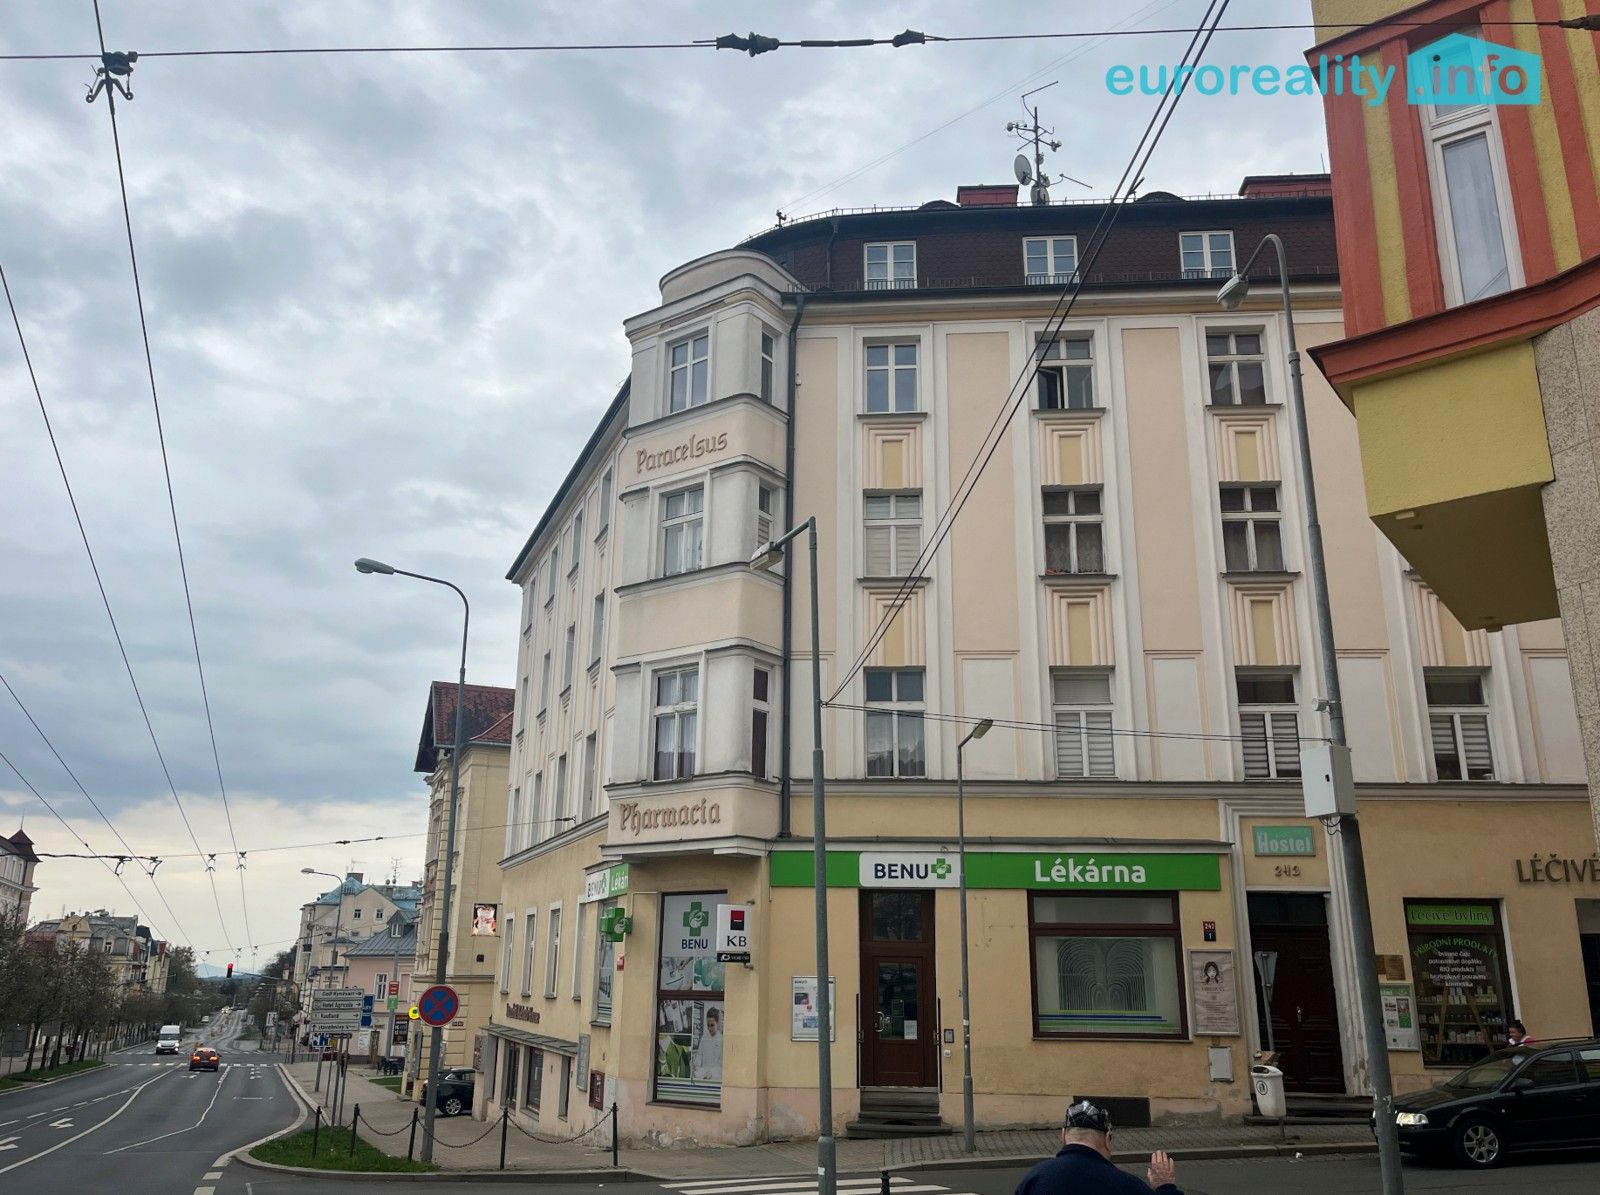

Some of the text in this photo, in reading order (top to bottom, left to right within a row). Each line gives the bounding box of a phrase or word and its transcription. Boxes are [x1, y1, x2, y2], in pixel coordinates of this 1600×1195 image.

[636, 432, 728, 474] Paracelsus
[620, 798, 721, 836] Pharmacia
[1256, 831, 1315, 853] Hostel
[873, 858, 1147, 883] BENU Lékárna
[1515, 852, 1600, 883] LÉČIVÉ
[681, 938, 708, 950] BENU
[726, 935, 747, 947] KB
